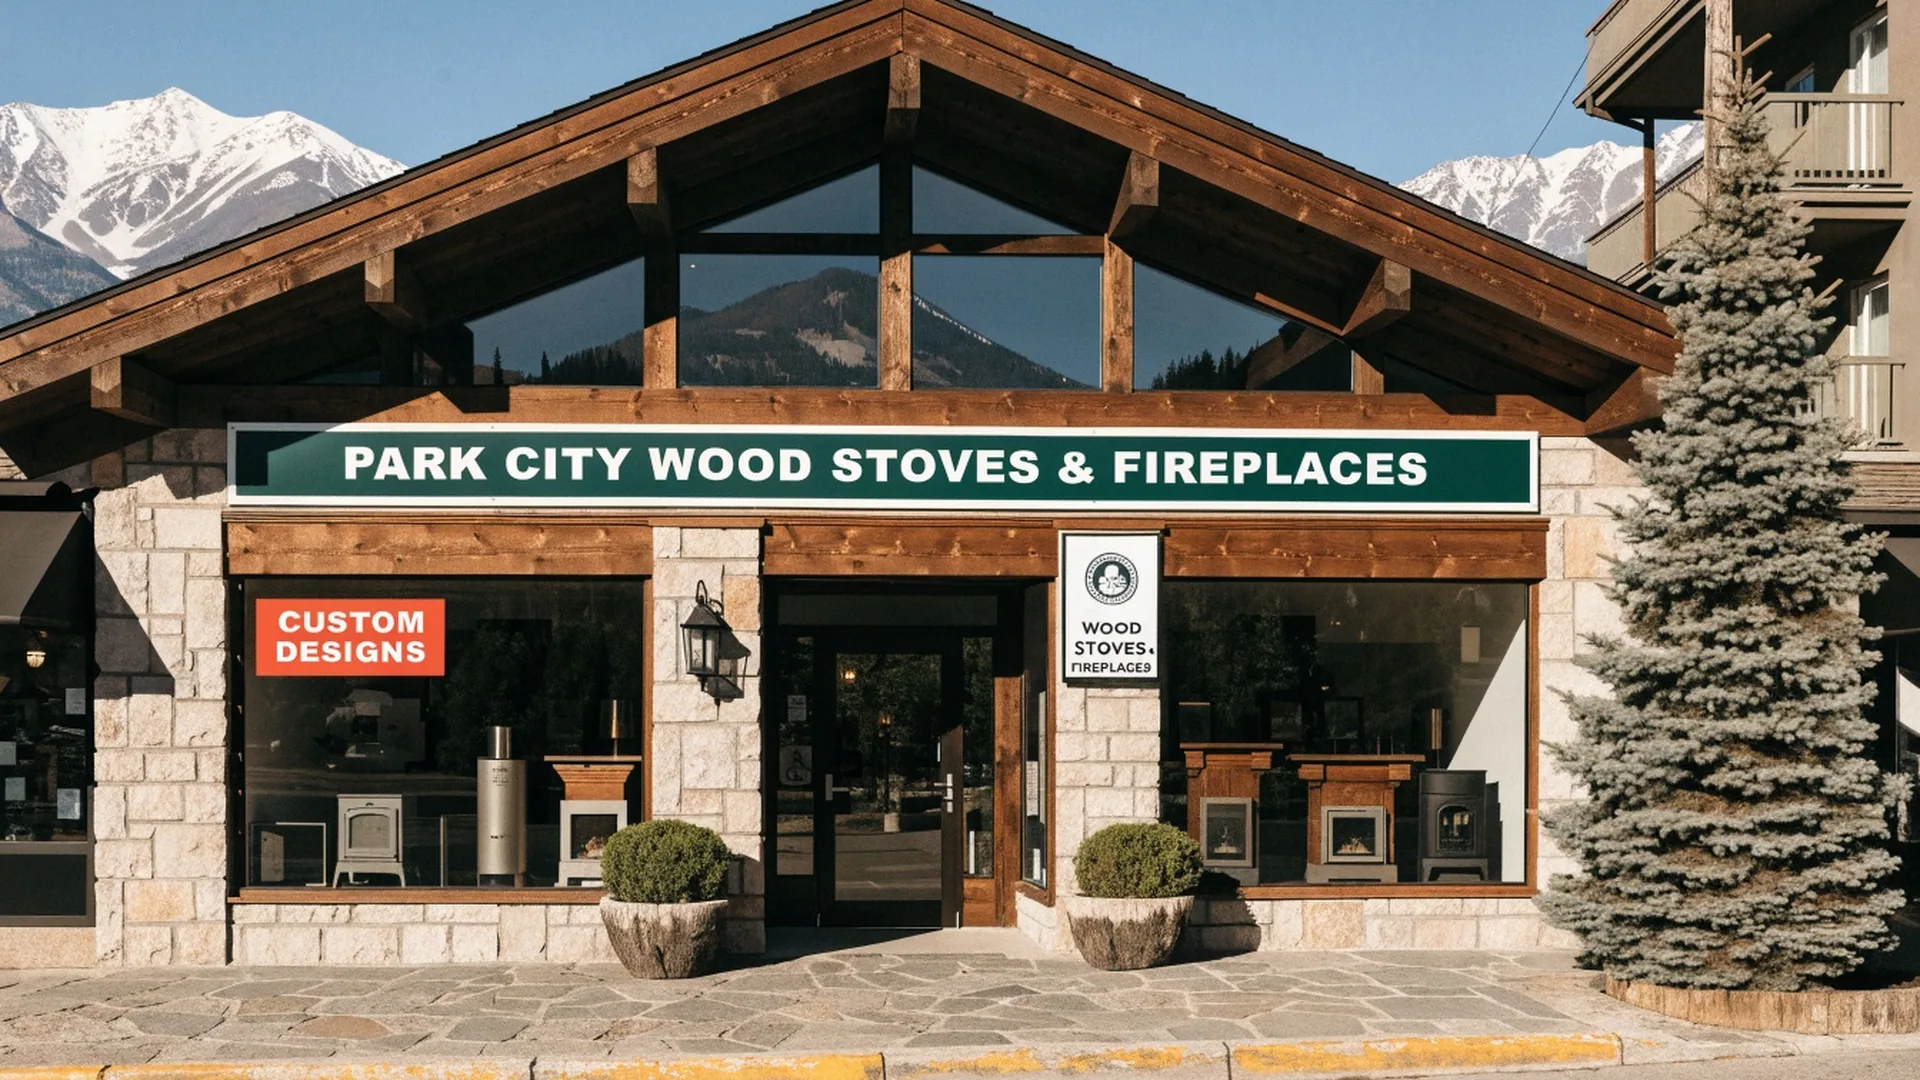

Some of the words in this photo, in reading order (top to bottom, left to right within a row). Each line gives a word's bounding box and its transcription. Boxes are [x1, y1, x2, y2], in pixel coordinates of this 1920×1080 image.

[344, 446, 487, 481] PARK
[505, 446, 632, 481] CITY
[648, 447, 811, 482] WOOD
[831, 448, 1040, 484] STOVES
[1058, 451, 1095, 485] &
[1114, 451, 1427, 486] FIREPLACES
[278, 610, 424, 634] CUSTOM
[1081, 621, 1142, 635] WOOD
[276, 640, 426, 664] DESIGNS
[1074, 640, 1147, 656] STOVES
